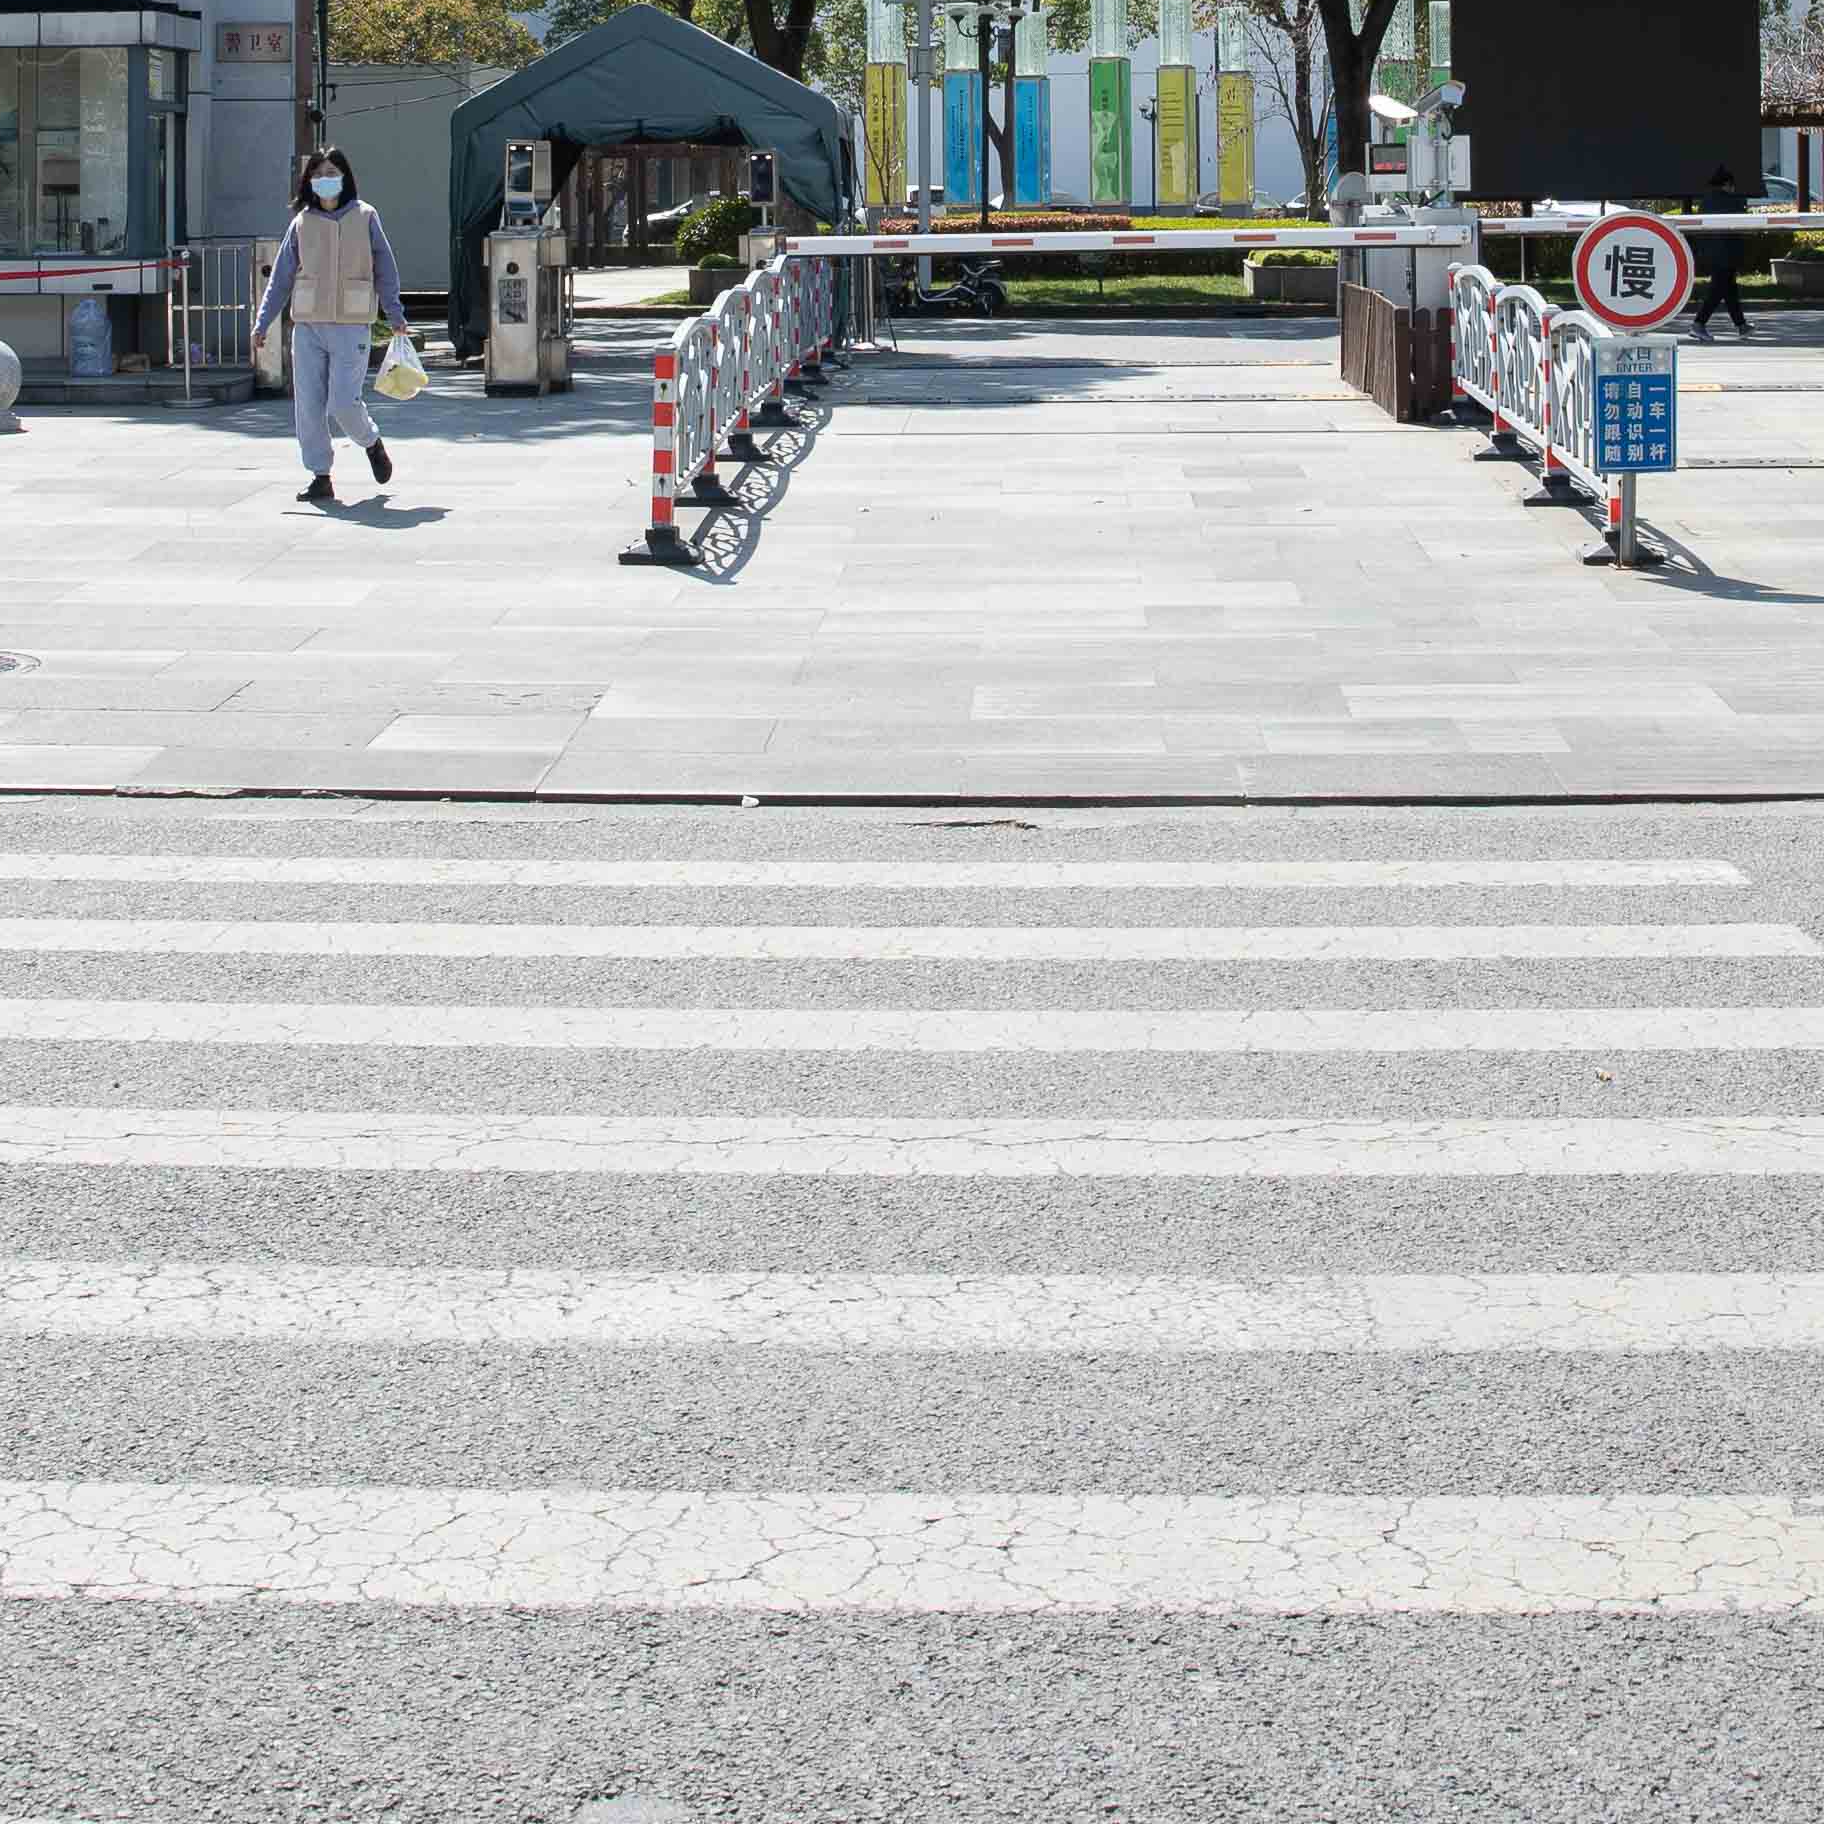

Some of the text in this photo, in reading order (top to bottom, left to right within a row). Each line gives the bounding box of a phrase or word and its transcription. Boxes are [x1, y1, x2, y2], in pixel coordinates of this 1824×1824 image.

[1604, 244, 1657, 300] 慢
[1616, 363, 1653, 373] ENTER
[1603, 381, 1622, 464] 请勿跟随
[1626, 380, 1645, 463] 自动识别
[1648, 385, 1667, 462] 一车一杆
